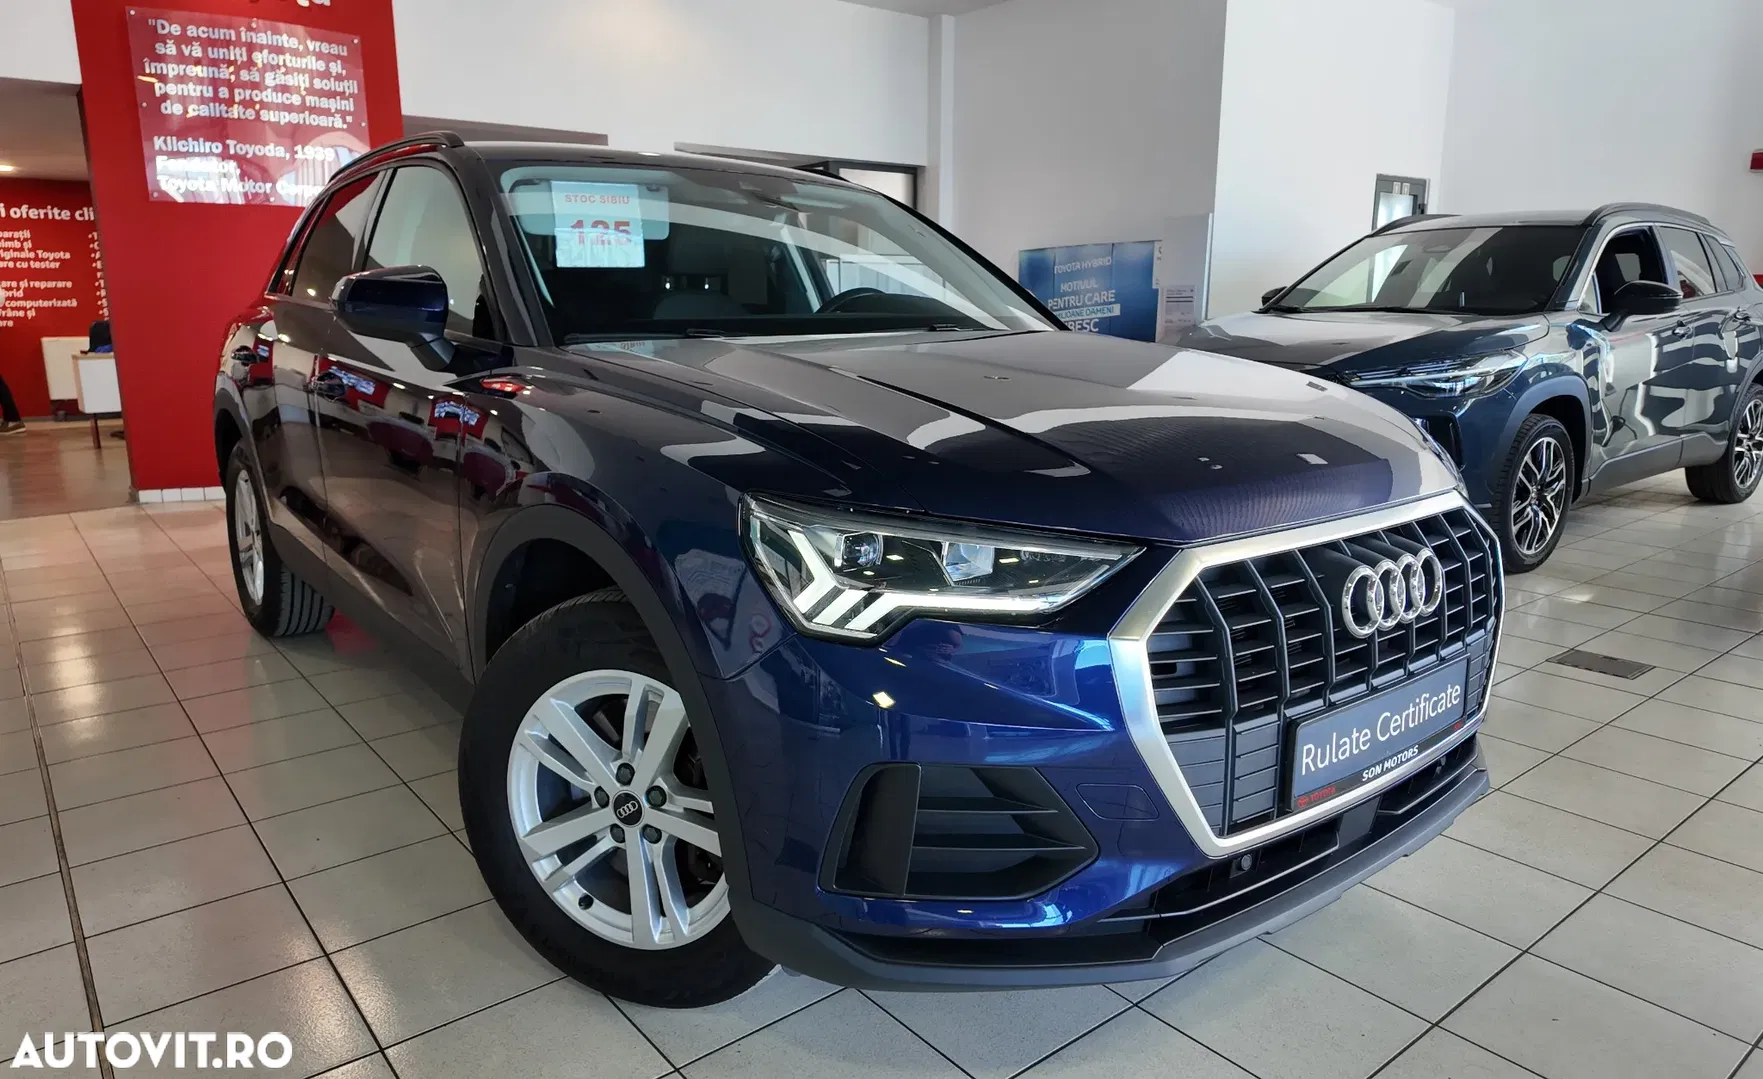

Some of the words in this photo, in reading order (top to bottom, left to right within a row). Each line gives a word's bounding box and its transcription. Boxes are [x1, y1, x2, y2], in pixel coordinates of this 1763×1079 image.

[186, 21, 236, 41] acum
[240, 26, 304, 53] înainte,
[306, 38, 348, 57] vreau
[155, 39, 178, 56] să
[181, 41, 203, 58] vă
[240, 66, 260, 83] să
[154, 79, 213, 98] pentru
[218, 86, 229, 99] a
[234, 86, 302, 107] produce
[160, 101, 184, 116] de
[188, 102, 256, 121] calitate
[226, 139, 291, 161] Toyoda,
[565, 194, 596, 204] STOC
[600, 195, 631, 205] SIBIU
[9, 204, 71, 220] oferite
[36, 249, 71, 261] Toyota
[16, 260, 28, 269] cu
[30, 260, 61, 270] tester
[1054, 261, 1081, 274] TOYOTA
[1081, 256, 1112, 270] HYBRID
[29, 280, 73, 290] reparare
[1060, 277, 1100, 293] MOTIVUL
[5, 298, 78, 309] computerizată
[1047, 295, 1083, 310] PENTRU
[1084, 290, 1116, 305] CARE
[1301, 728, 1371, 775] Rulate
[1377, 684, 1461, 741] Certificate
[1362, 763, 1383, 781] SON
[1383, 744, 1419, 772] MOTORS
